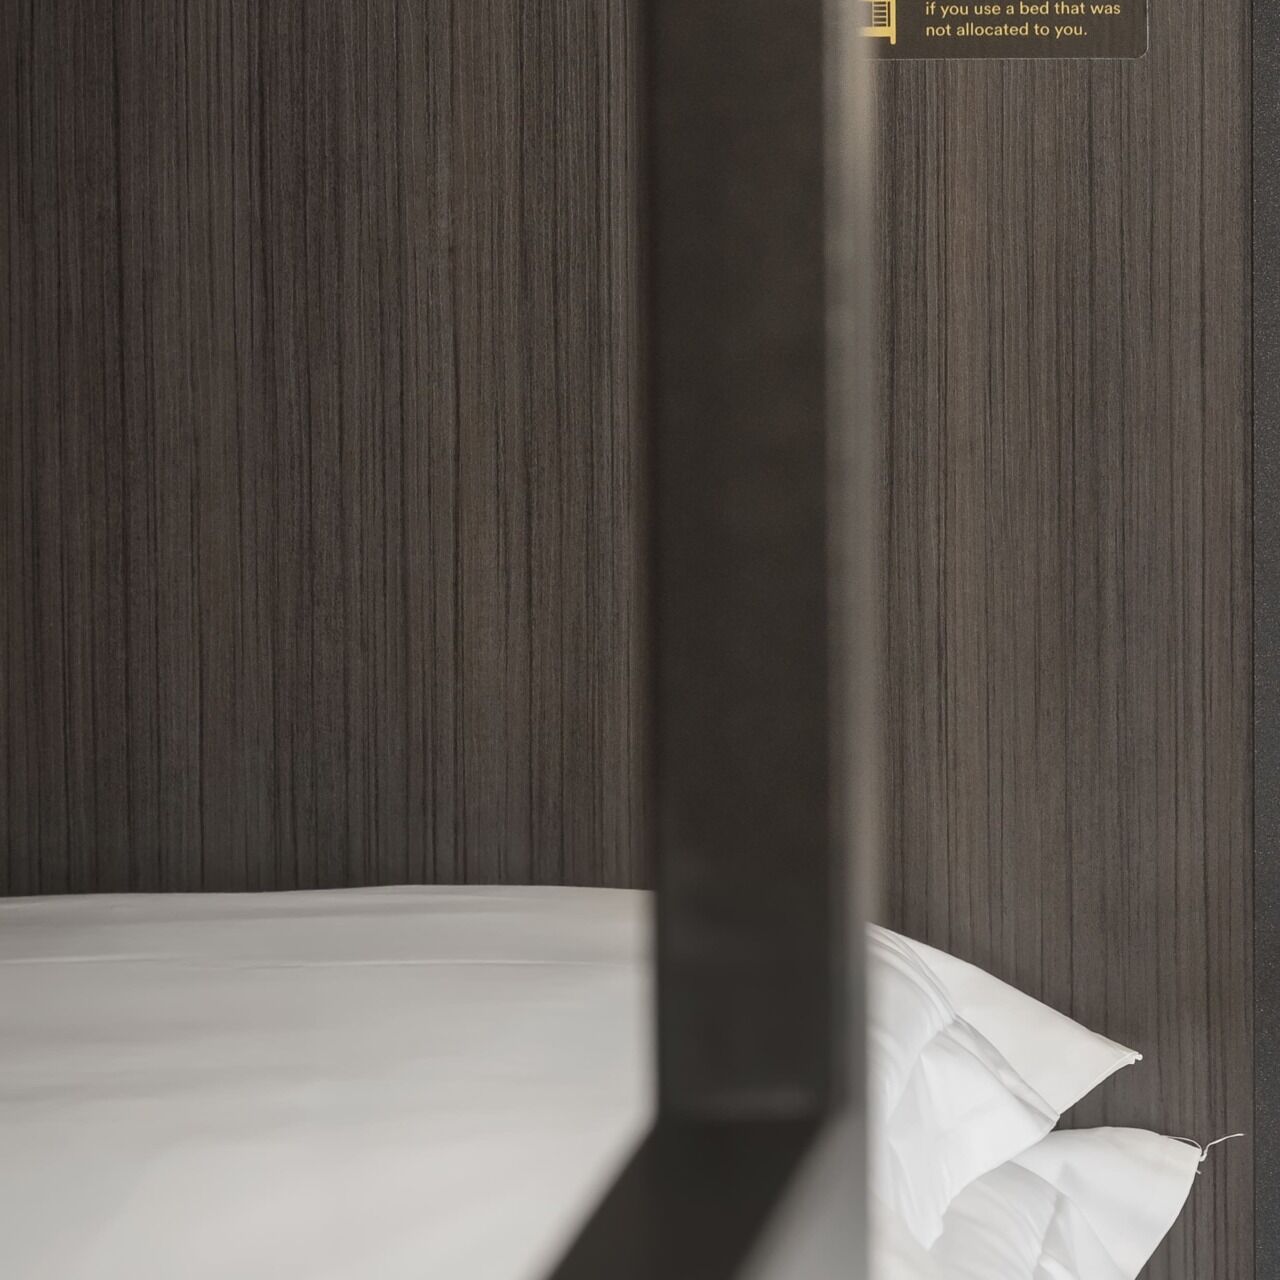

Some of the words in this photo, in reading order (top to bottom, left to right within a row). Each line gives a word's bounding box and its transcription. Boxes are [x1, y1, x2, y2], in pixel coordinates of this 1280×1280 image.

[926, 2, 935, 15] if
[941, 5, 968, 18] you
[975, 5, 1000, 15] use
[1006, 5, 1014, 14] a
[1020, 1, 1048, 14] bed
[1055, 1, 1085, 14] that
[1091, 5, 1120, 14] was
[926, 24, 951, 36] not
[957, 22, 1028, 36] allocated
[1034, 24, 1049, 35] to
[1055, 26, 1087, 39] you.
